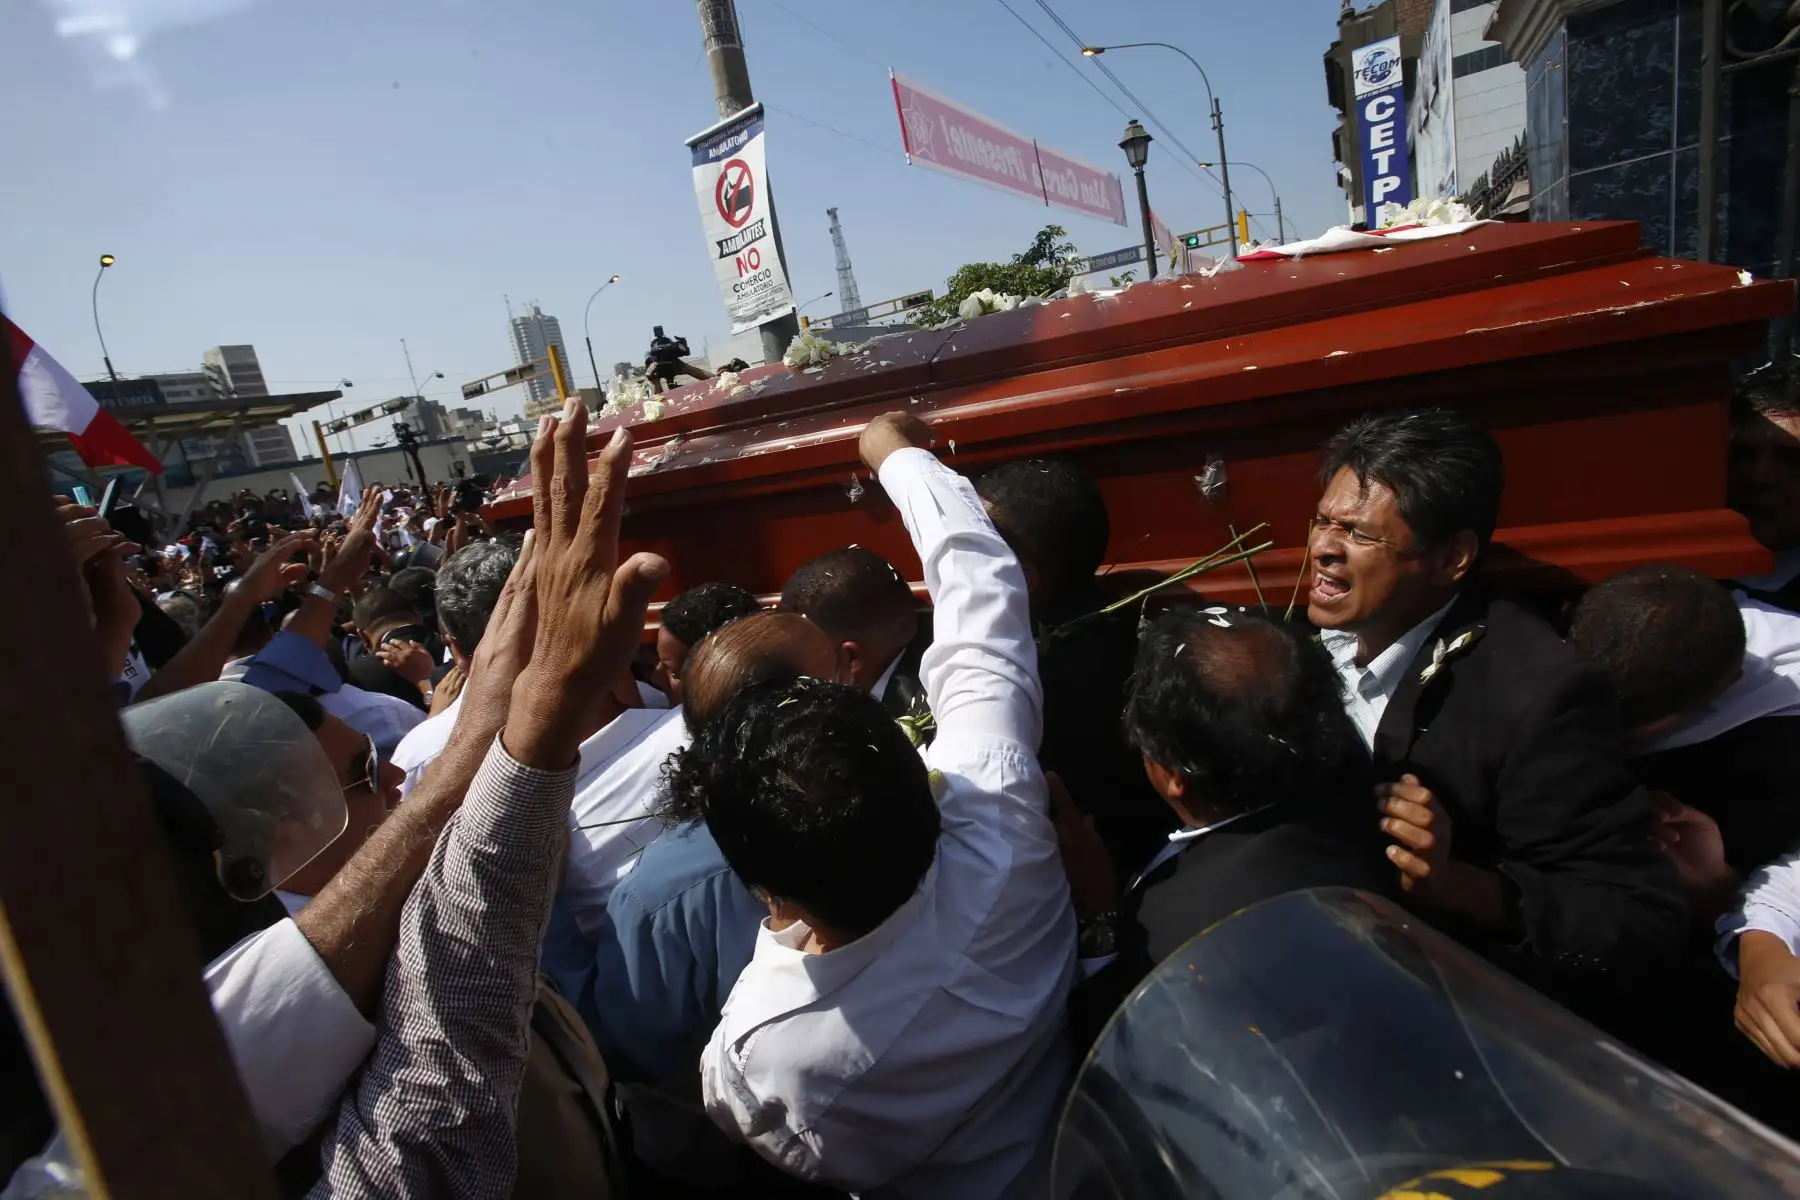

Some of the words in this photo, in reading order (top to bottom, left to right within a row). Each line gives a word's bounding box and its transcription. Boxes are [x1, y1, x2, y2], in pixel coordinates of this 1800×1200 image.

[1354, 56, 1401, 80] TECOM
[735, 247, 761, 278] NO
[732, 268, 772, 293] COMERCIO
[736, 279, 774, 302] AMBULATORIO
